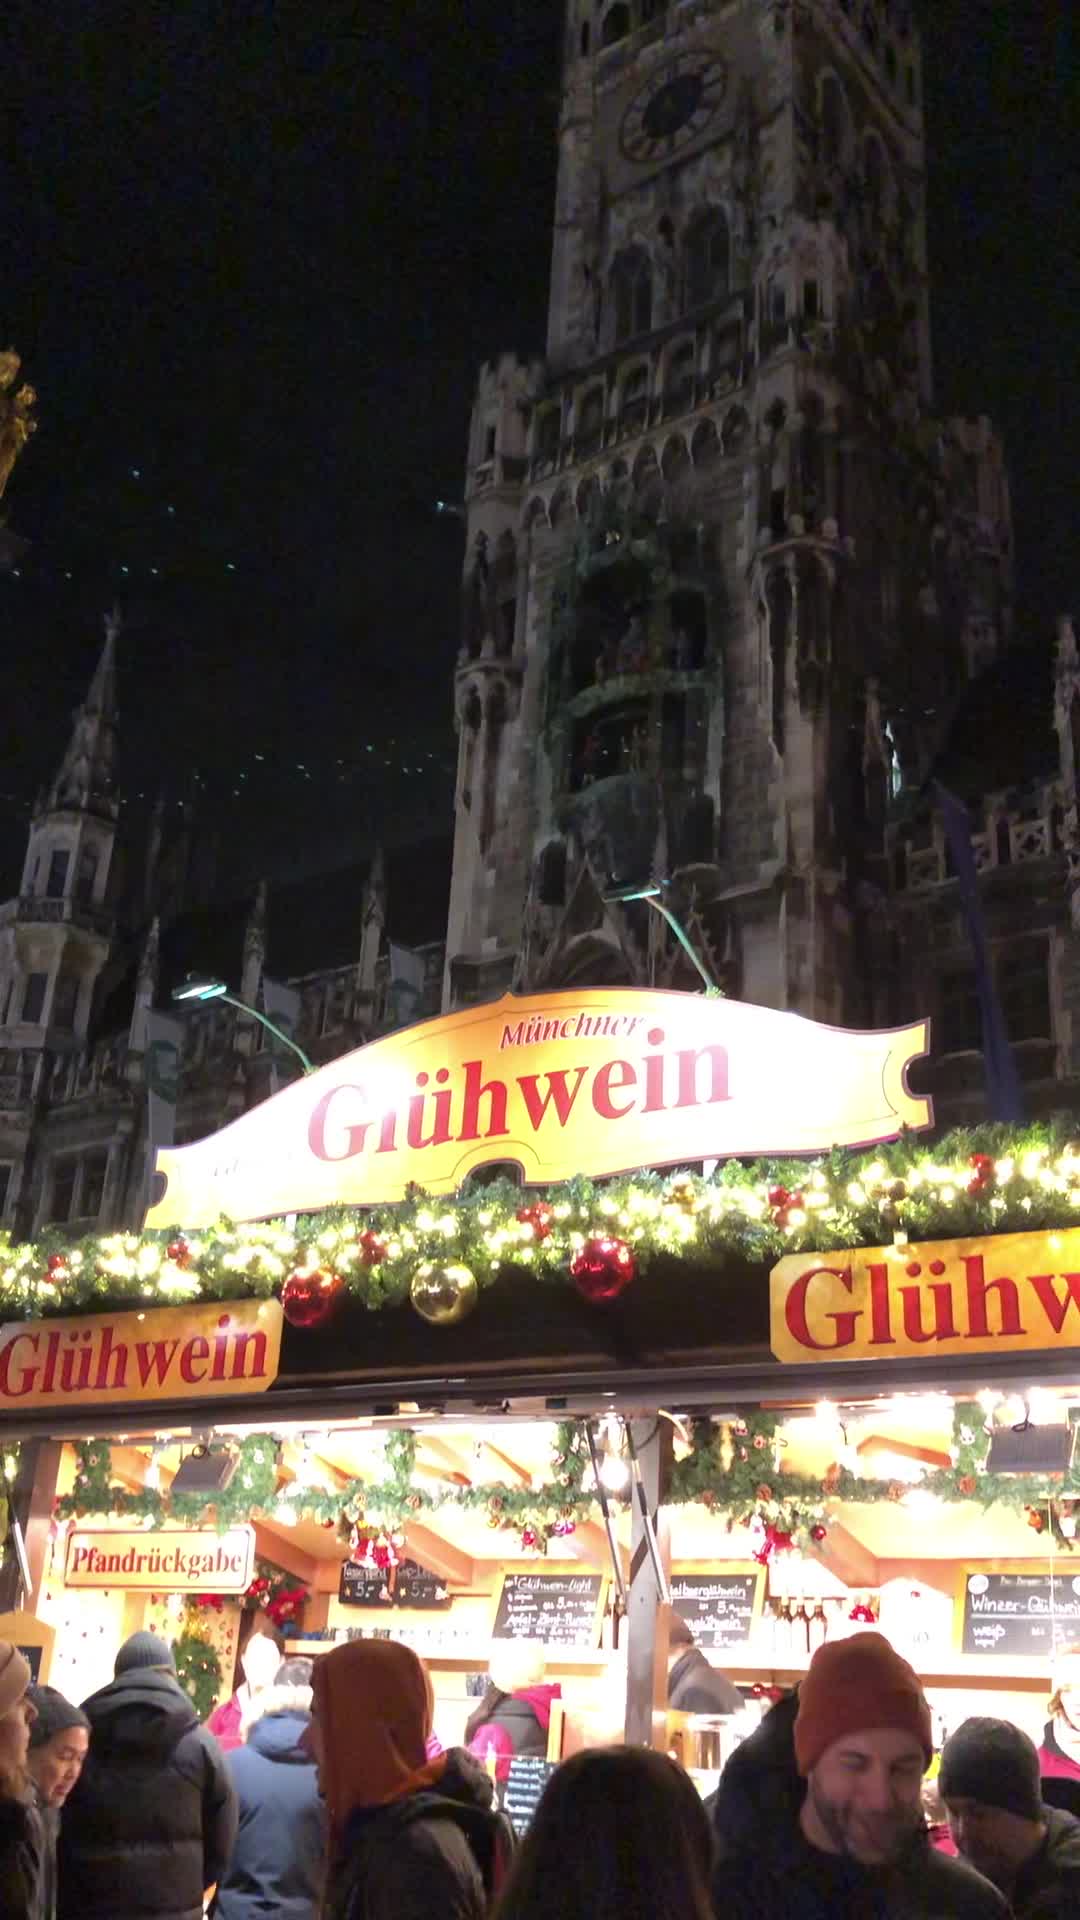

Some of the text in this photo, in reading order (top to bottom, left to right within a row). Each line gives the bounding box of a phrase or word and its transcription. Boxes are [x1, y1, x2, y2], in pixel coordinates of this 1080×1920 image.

[500, 1012, 646, 1051] Münchner
[307, 1027, 734, 1162] Glühwein
[0, 1313, 268, 1397] Glühwein
[71, 1547, 242, 1580] Pfandrückgabe
